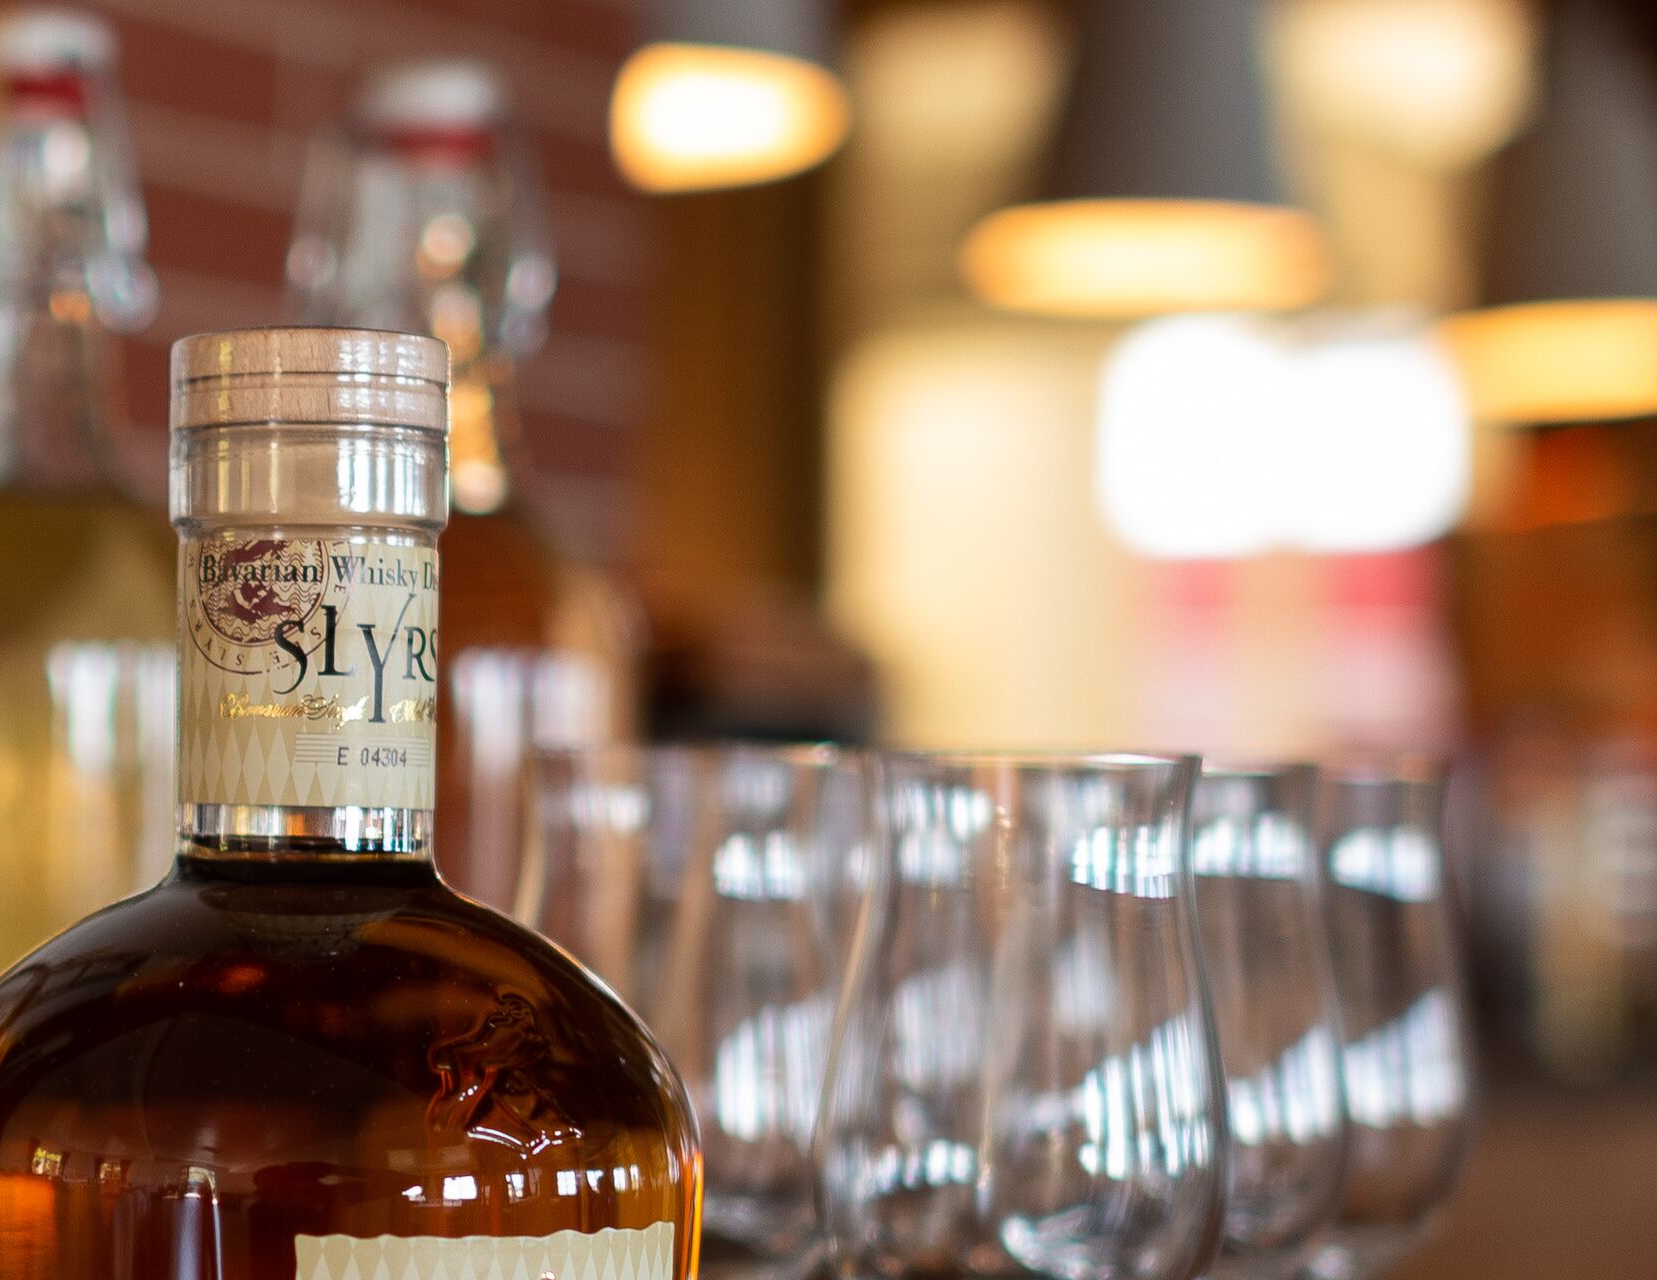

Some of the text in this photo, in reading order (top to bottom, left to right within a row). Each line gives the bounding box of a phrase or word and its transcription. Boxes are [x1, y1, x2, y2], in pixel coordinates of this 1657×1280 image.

[202, 553, 320, 584] Bavarian
[328, 556, 416, 596] Whisky
[337, 746, 408, 769] E 04304
